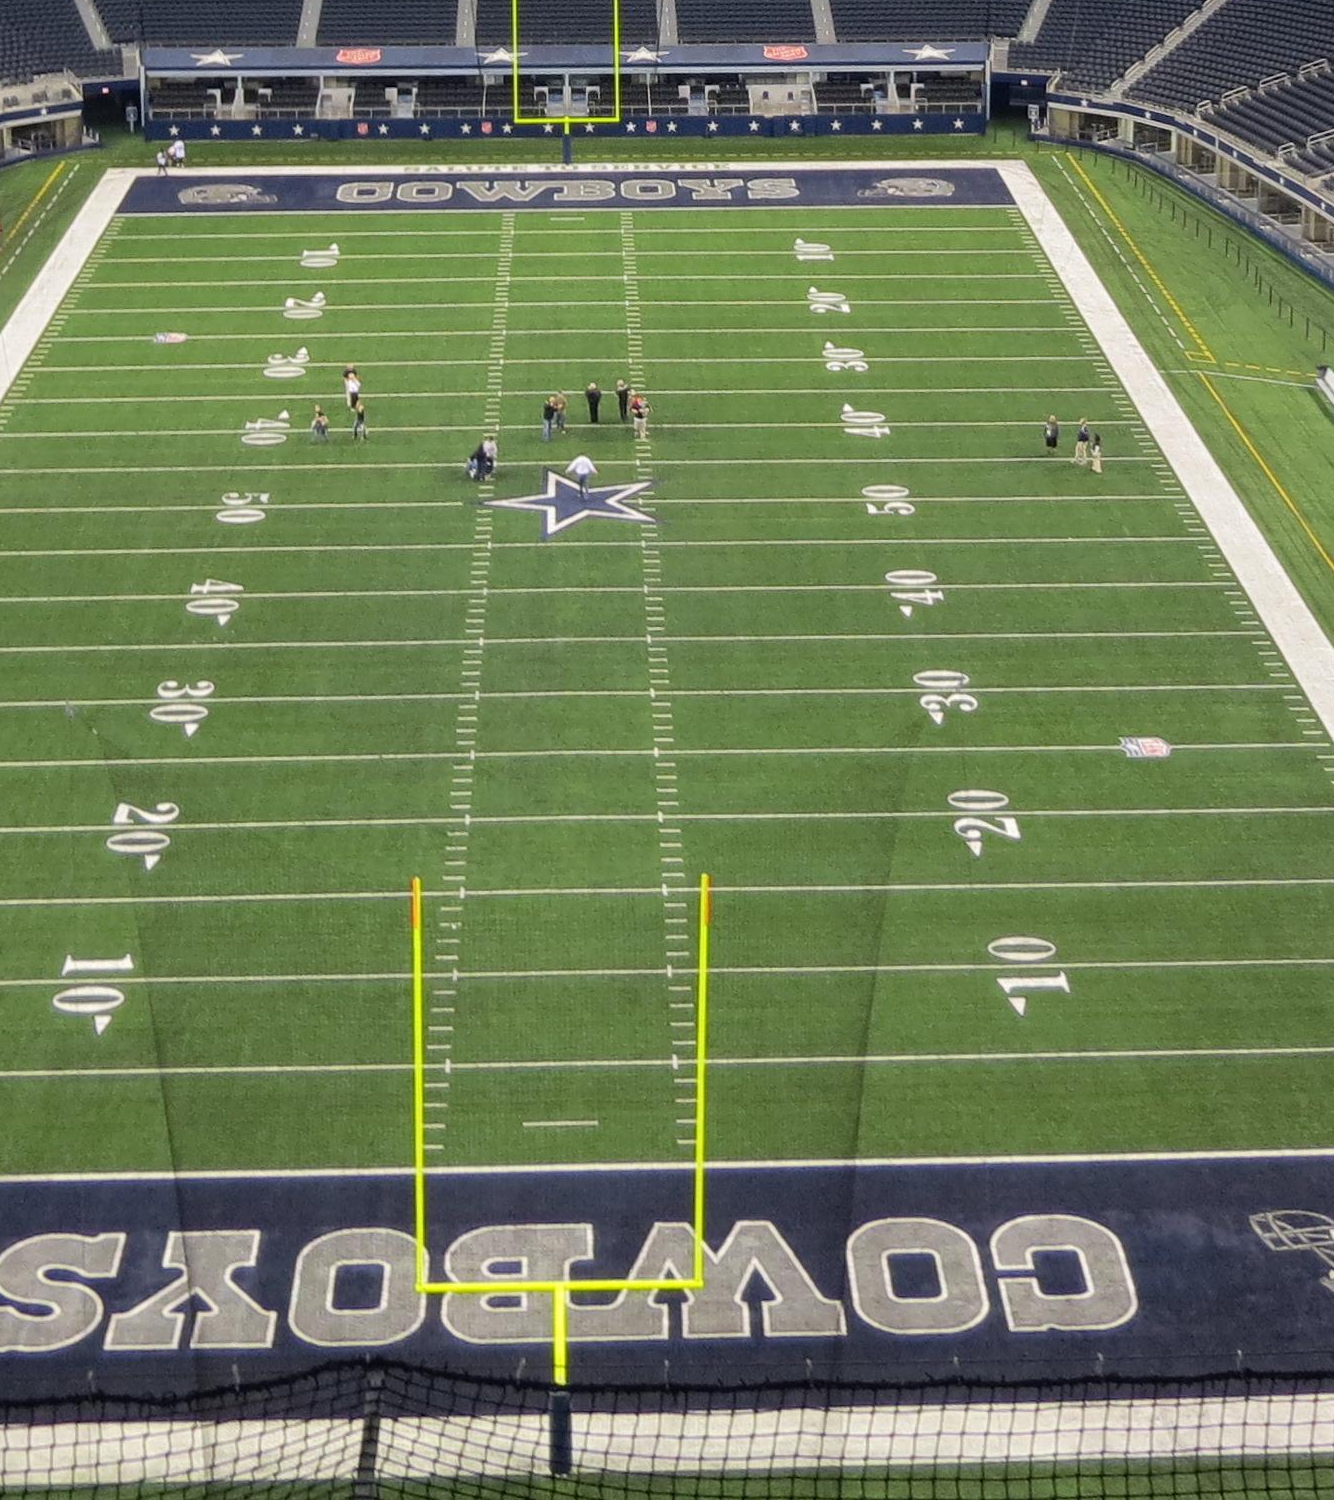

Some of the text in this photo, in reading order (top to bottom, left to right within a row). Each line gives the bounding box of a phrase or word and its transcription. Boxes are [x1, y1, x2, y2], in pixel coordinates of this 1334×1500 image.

[335, 176, 800, 204] COWBOYS
[806, 291, 851, 313] 20
[263, 352, 310, 379] 30
[821, 347, 869, 372] 30
[240, 417, 291, 446] 40
[840, 410, 892, 438] 40
[215, 491, 271, 525] 50
[861, 484, 916, 516] 50
[184, 578, 245, 616] 40
[884, 568, 945, 606] 40
[149, 679, 216, 724] 30
[912, 669, 979, 712] 30
[106, 801, 180, 854] 20
[947, 789, 1021, 840] 20
[52, 952, 135, 1014] 10
[987, 936, 1071, 995] 10
